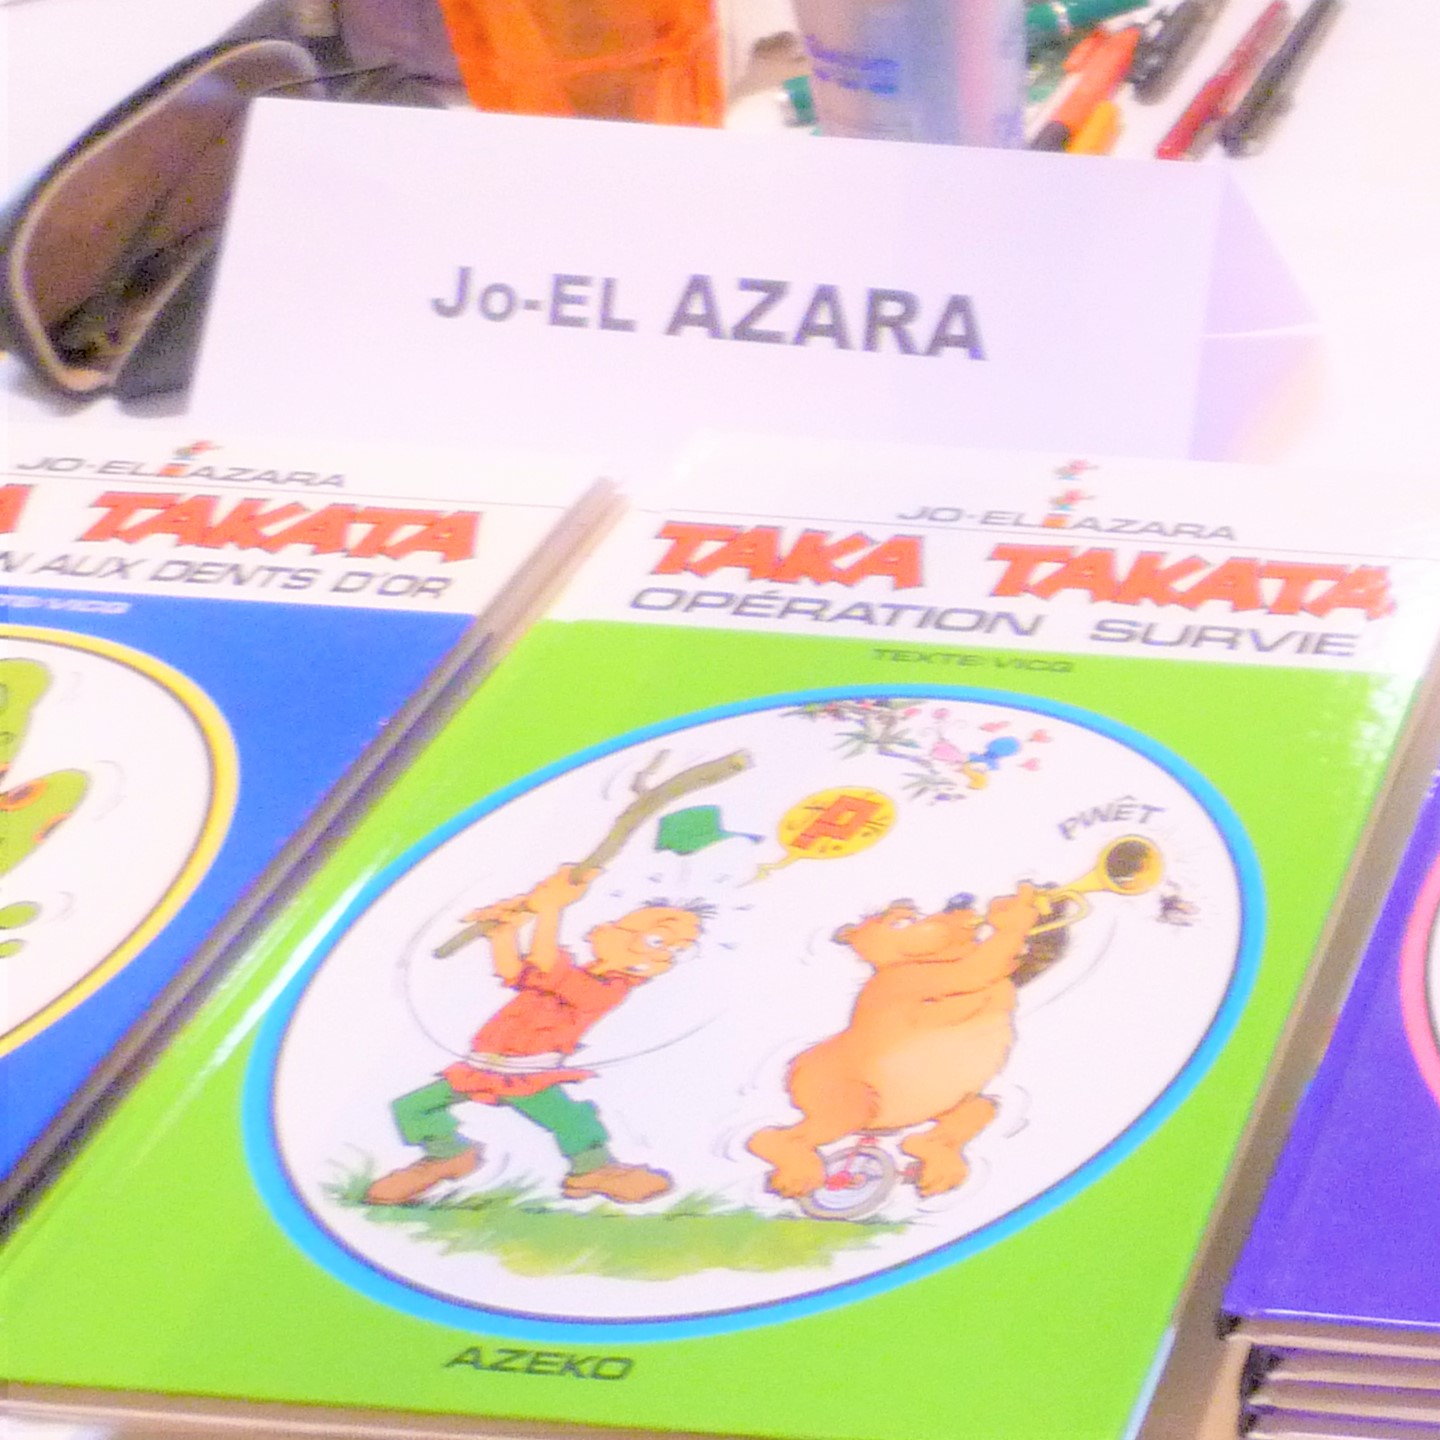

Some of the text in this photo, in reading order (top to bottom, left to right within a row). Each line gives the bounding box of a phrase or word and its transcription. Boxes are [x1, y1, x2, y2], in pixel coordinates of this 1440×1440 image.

[665, 273, 989, 361] AZARA
[184, 465, 345, 488] AZARA
[74, 491, 483, 563] TAKATA
[1066, 515, 1238, 541] AZARA
[32, 553, 148, 580] AUX
[148, 560, 323, 590] DENTS
[330, 570, 453, 599] D'OR
[650, 520, 1397, 620] TAKA TAKATA
[629, 586, 1362, 657] OPÉRATION SURVIE
[442, 1346, 635, 1381] AZEKO
